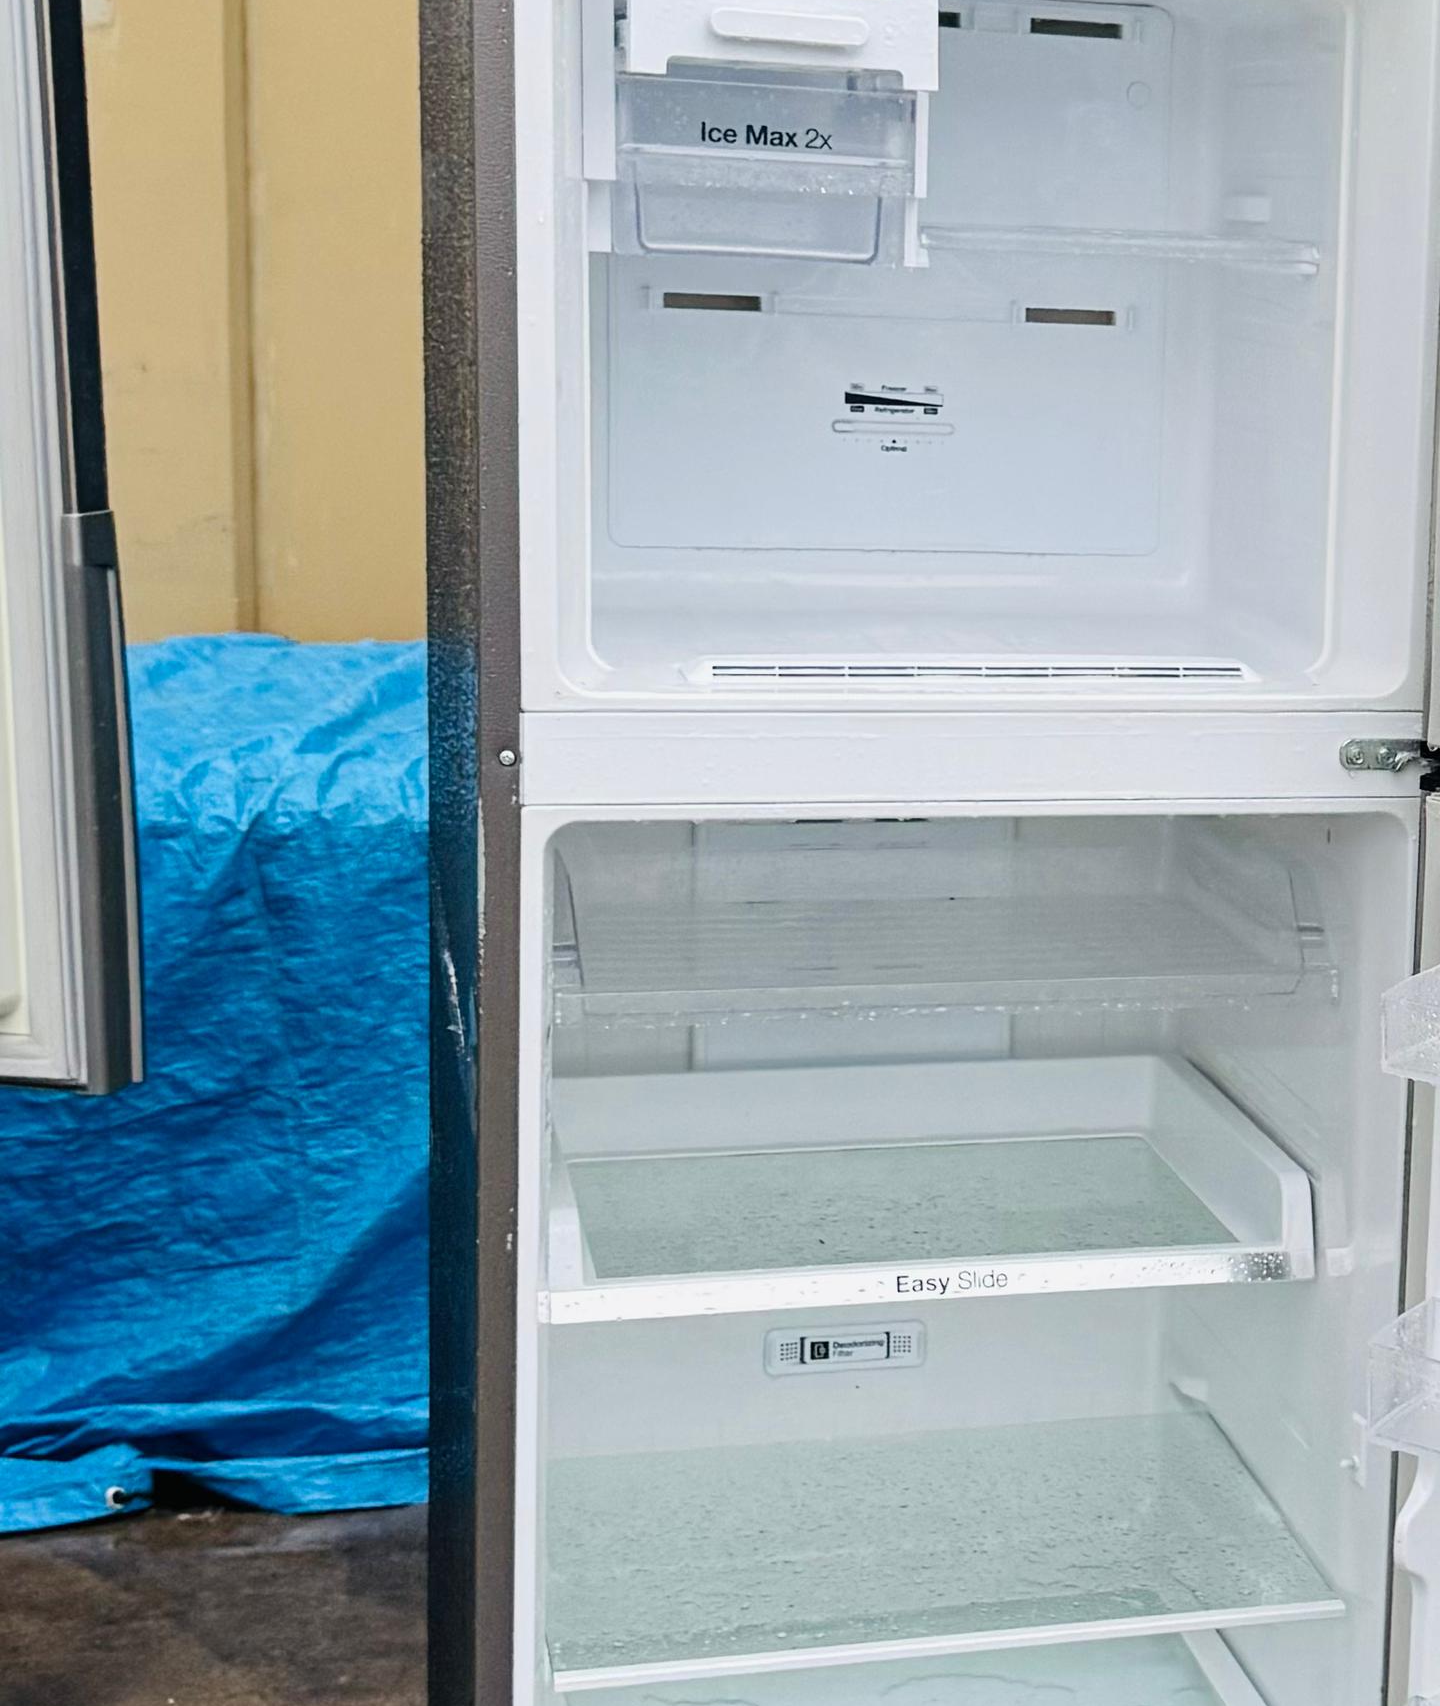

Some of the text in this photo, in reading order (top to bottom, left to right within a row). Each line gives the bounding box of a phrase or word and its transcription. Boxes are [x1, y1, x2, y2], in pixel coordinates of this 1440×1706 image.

[701, 121, 832, 150] Ice Max 2x
[896, 1269, 1008, 1295] Easy Slide
